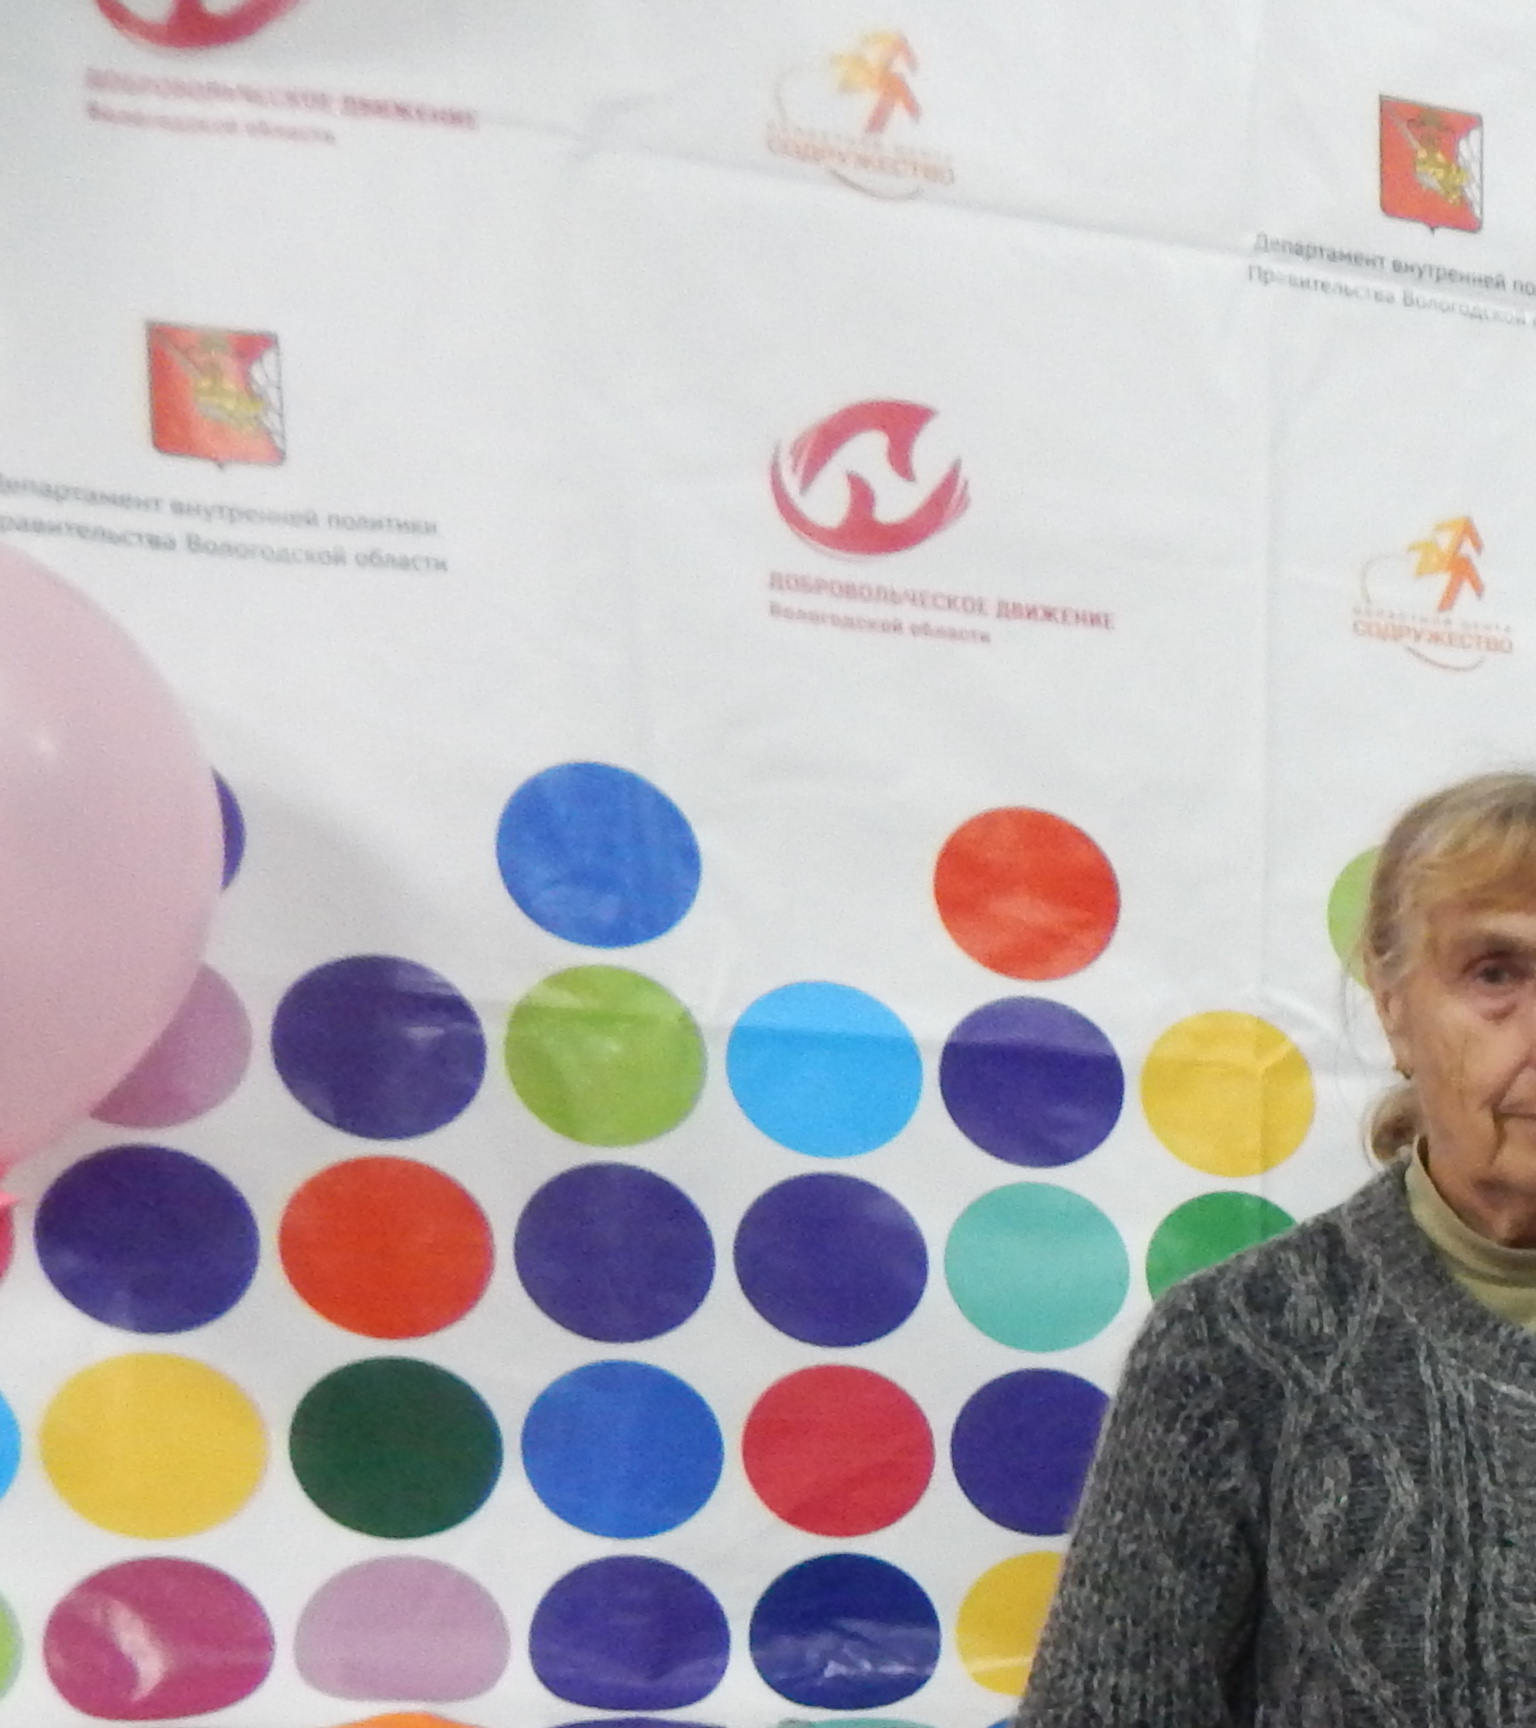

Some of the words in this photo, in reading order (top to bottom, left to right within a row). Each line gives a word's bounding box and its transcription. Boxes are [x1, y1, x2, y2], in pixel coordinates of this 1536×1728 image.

[1253, 231, 1386, 270] Департамент
[1392, 257, 1506, 292] внутренней
[0, 472, 160, 513] епартамент
[170, 500, 319, 528] внутренней
[328, 512, 438, 535] политики
[0, 515, 177, 551] равительства
[186, 532, 347, 567] Вологодской
[768, 571, 987, 616] ДОБРОВОЛЬЧЕСКОЕ
[997, 598, 1115, 631] ДВИЖЕНИЕ
